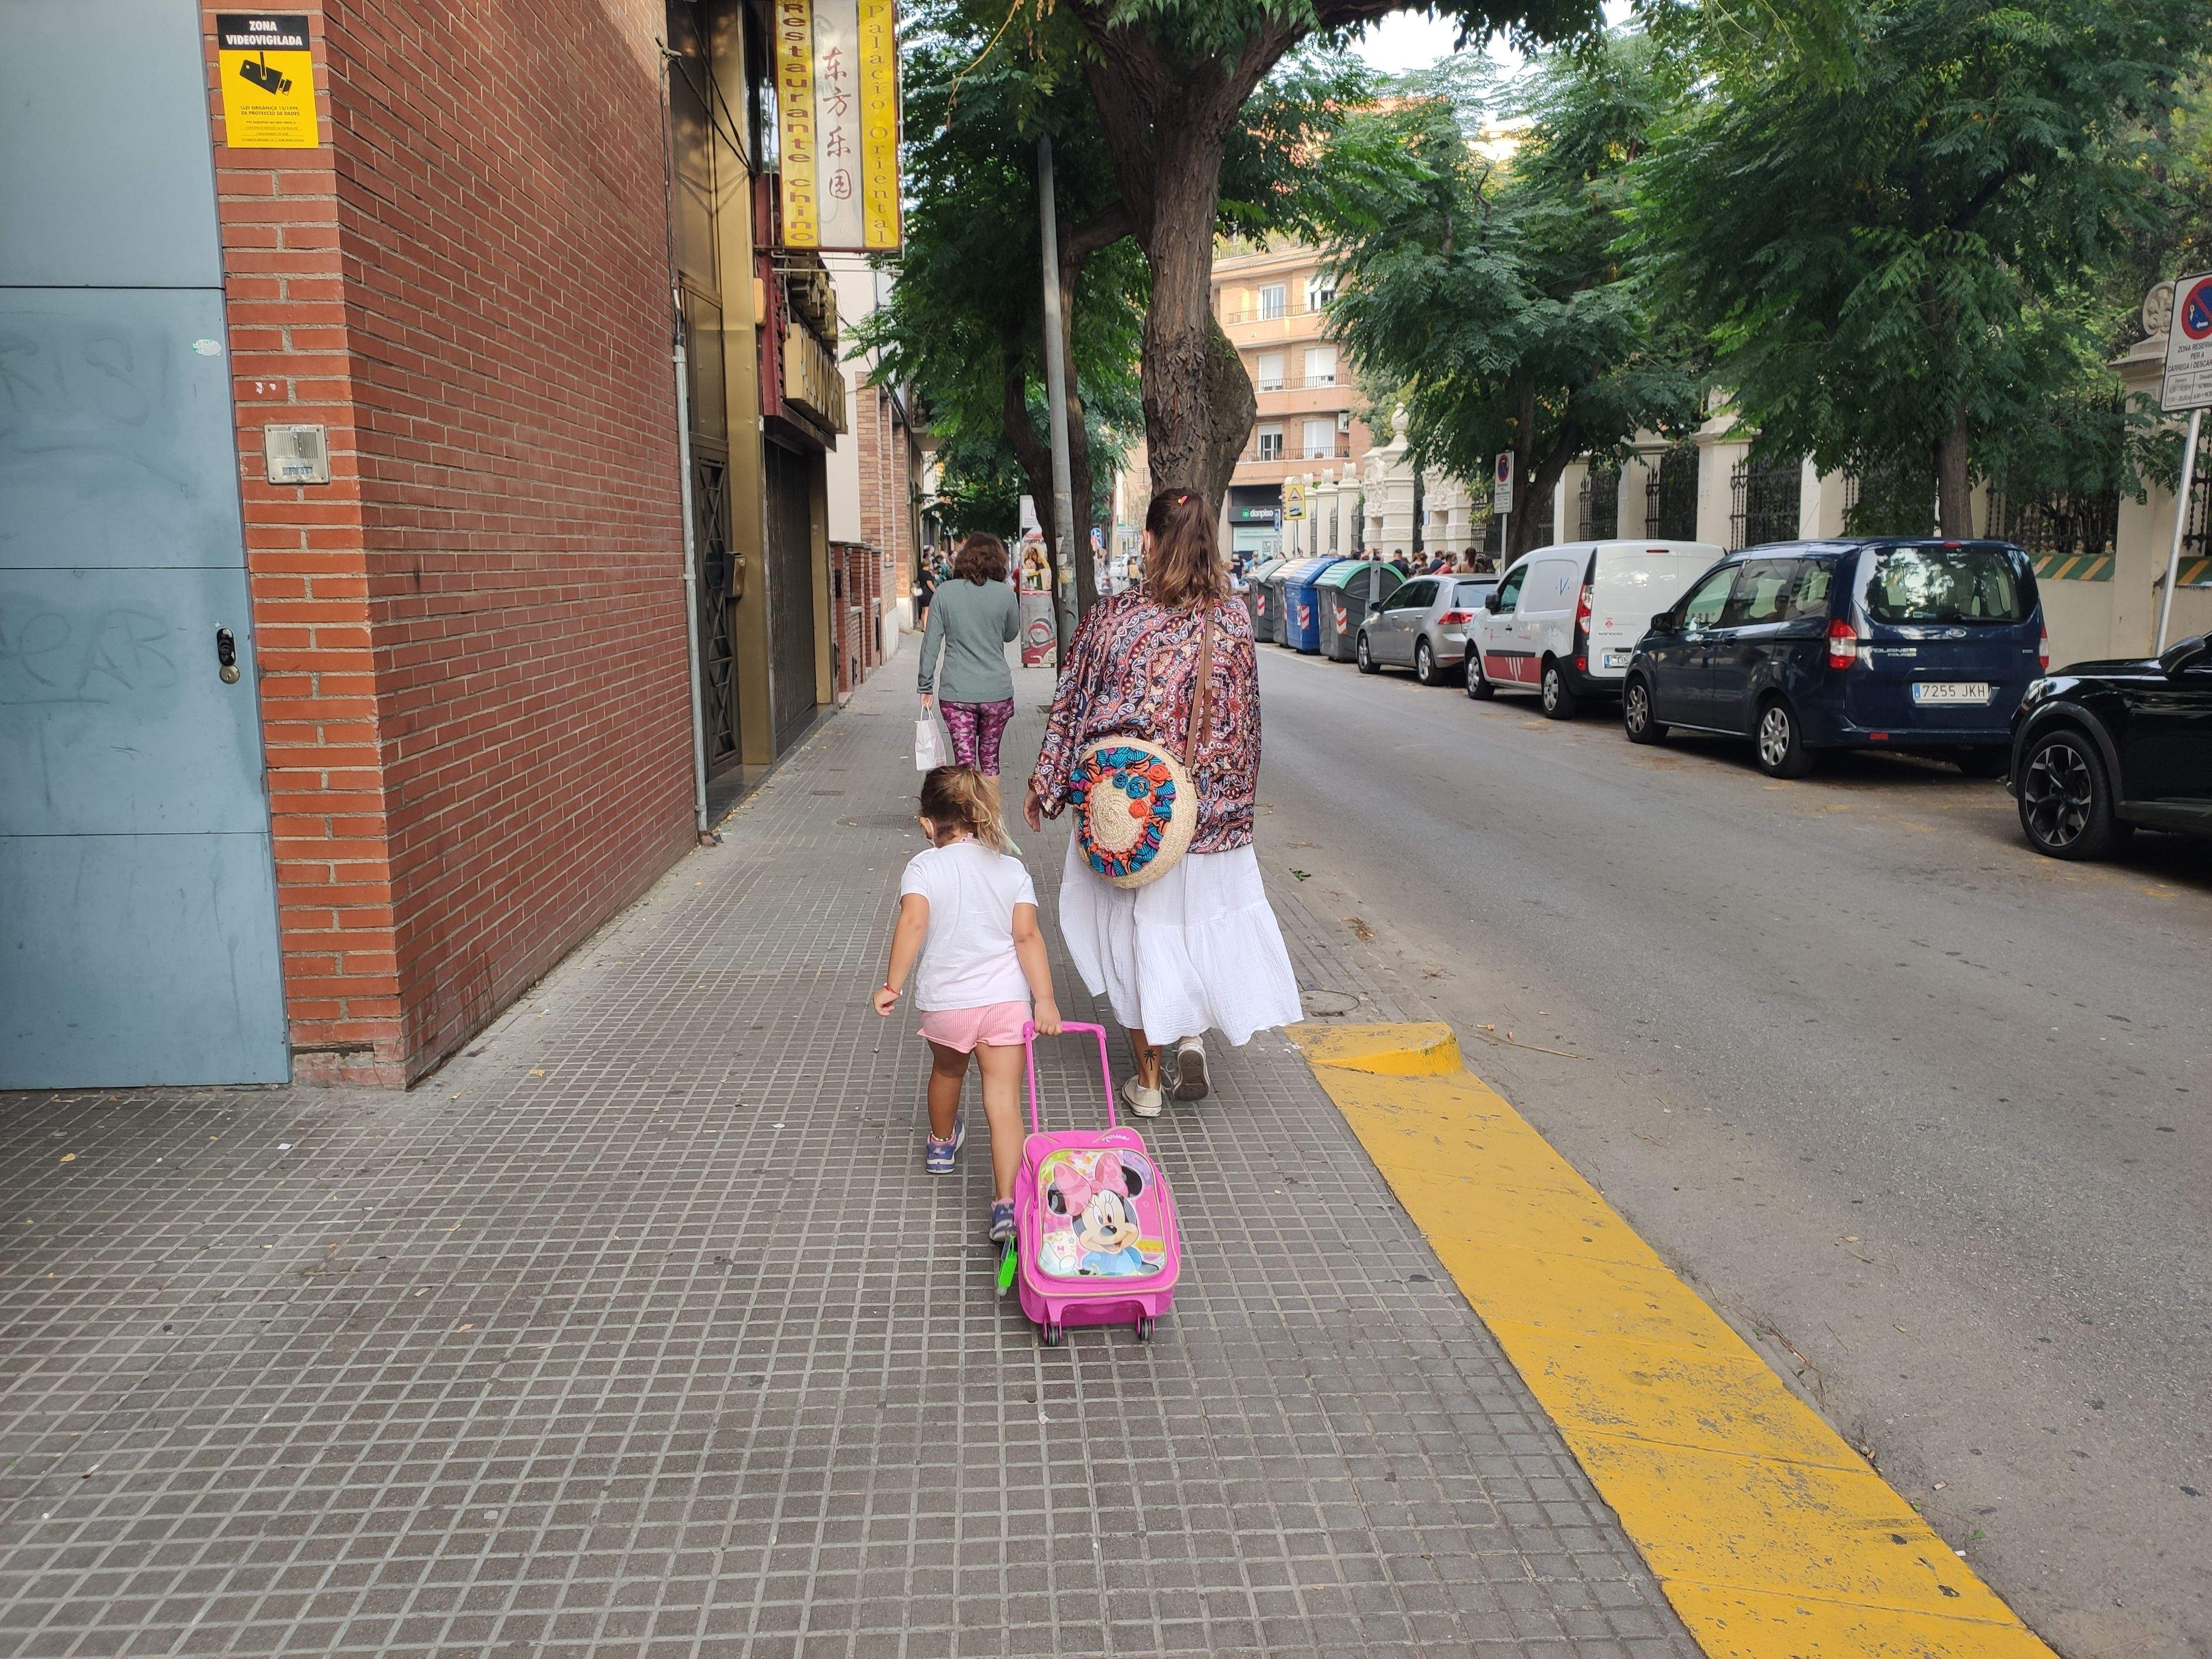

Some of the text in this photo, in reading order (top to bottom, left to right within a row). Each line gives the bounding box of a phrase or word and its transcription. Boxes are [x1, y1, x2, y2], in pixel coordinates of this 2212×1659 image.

[249, 20, 278, 32] ZONA
[226, 34, 303, 46] VIDEOVIGILADA
[867, 5, 889, 243] Palacio Oriental
[789, 178, 815, 242] chino
[2178, 345, 2191, 353] ZONA
[1250, 508, 1274, 519] donpiso
[1922, 685, 1985, 697] 7255 JKH
